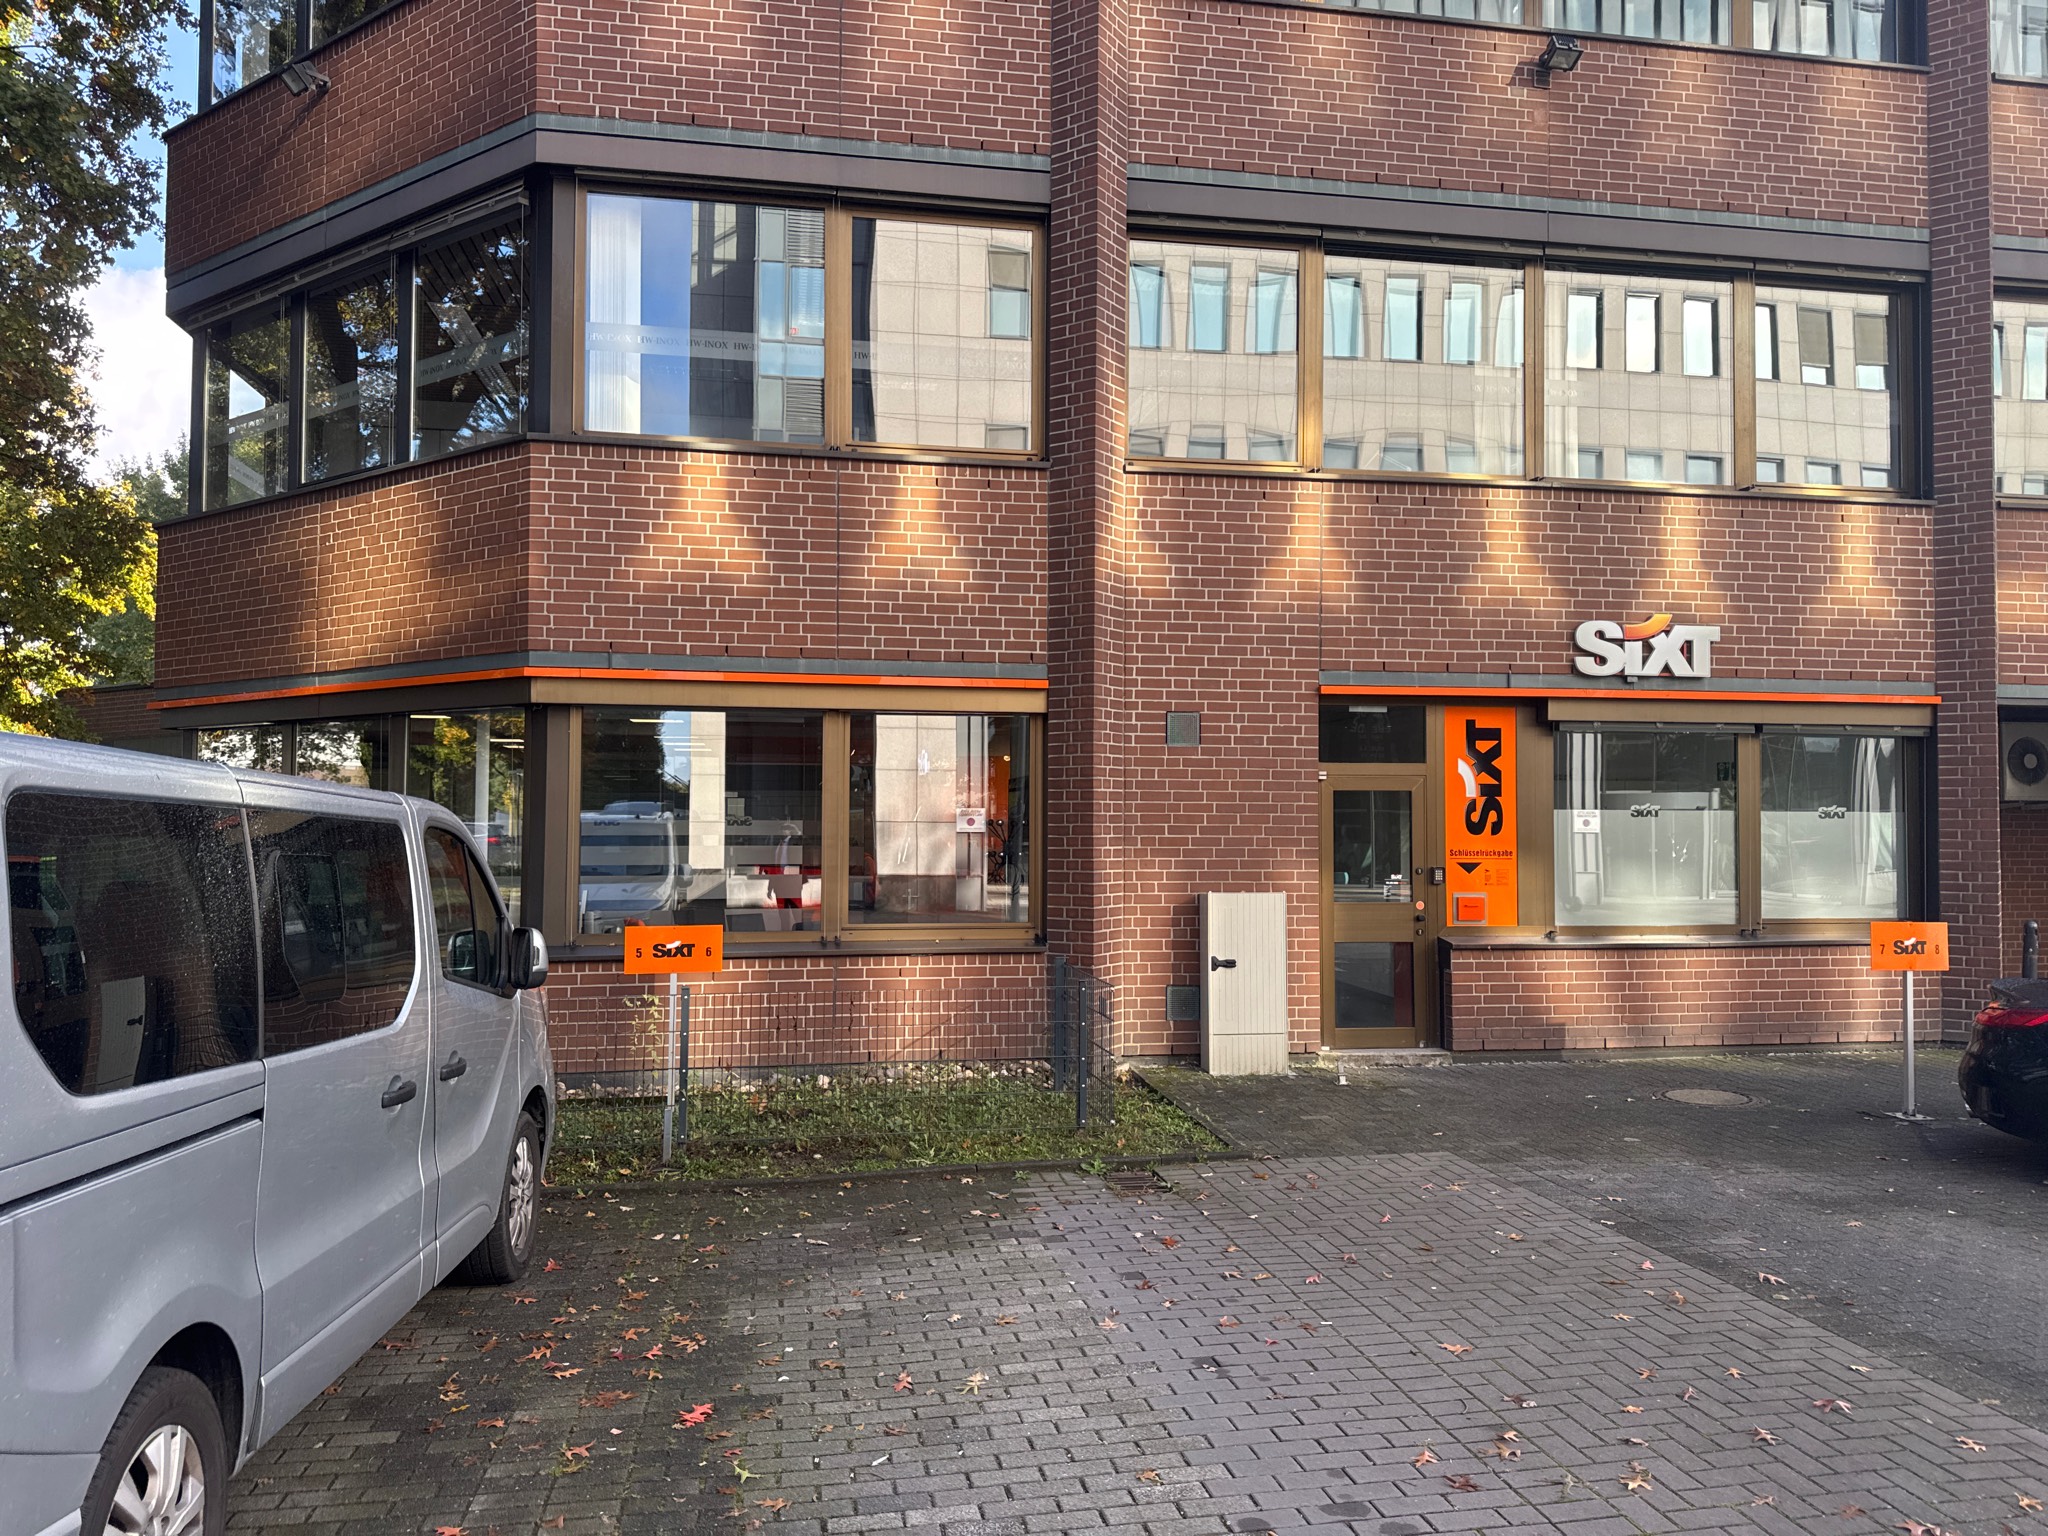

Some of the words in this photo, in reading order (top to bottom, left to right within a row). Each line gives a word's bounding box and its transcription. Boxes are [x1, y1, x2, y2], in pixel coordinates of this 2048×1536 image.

[1449, 849, 1513, 858] Schlüsselrückgabe
[635, 948, 642, 958] 5
[706, 947, 712, 957] 6
[1880, 944, 1885, 954] 7
[1935, 944, 1940, 954] 8
